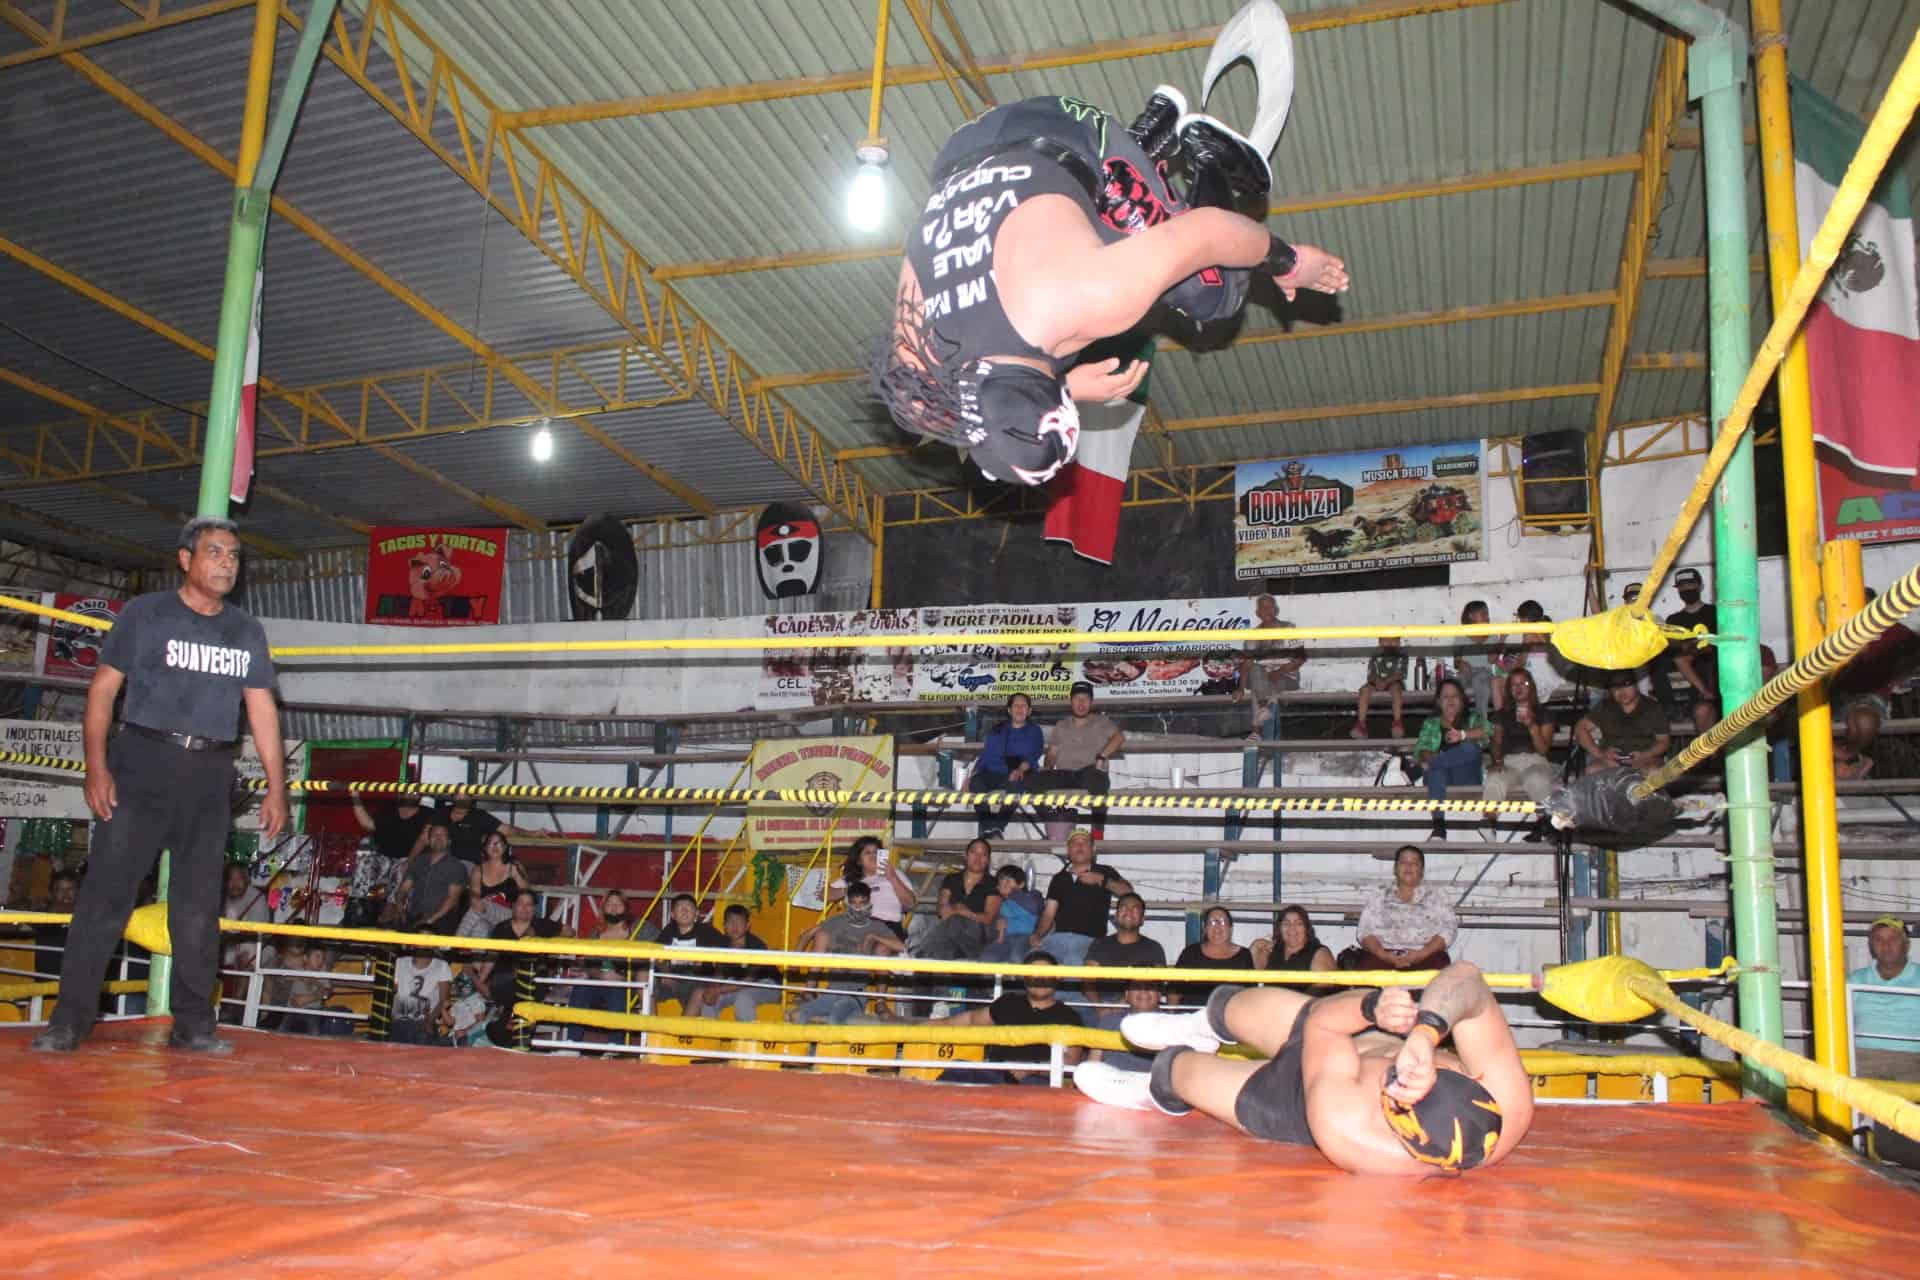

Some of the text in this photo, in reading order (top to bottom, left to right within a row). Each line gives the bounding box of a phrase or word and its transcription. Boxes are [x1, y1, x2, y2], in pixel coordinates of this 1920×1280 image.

[932, 234, 993, 280] VALE
[1364, 470, 1398, 481] MUSICA
[1248, 487, 1341, 525] BONANZA
[1238, 529, 1267, 542] VIDEO
[378, 533, 497, 557] TACOS Y TORTAS
[943, 613, 1055, 627] TIGRE PADILLA
[166, 639, 251, 678] SUAVECITO
[1000, 670, 1026, 682] 632
[1030, 670, 1050, 682] 90
[777, 678, 807, 689] CEL.
[6, 727, 81, 742] INDUSTRIALES
[849, 1043, 865, 1056] 68
[938, 1044, 954, 1058] 69
